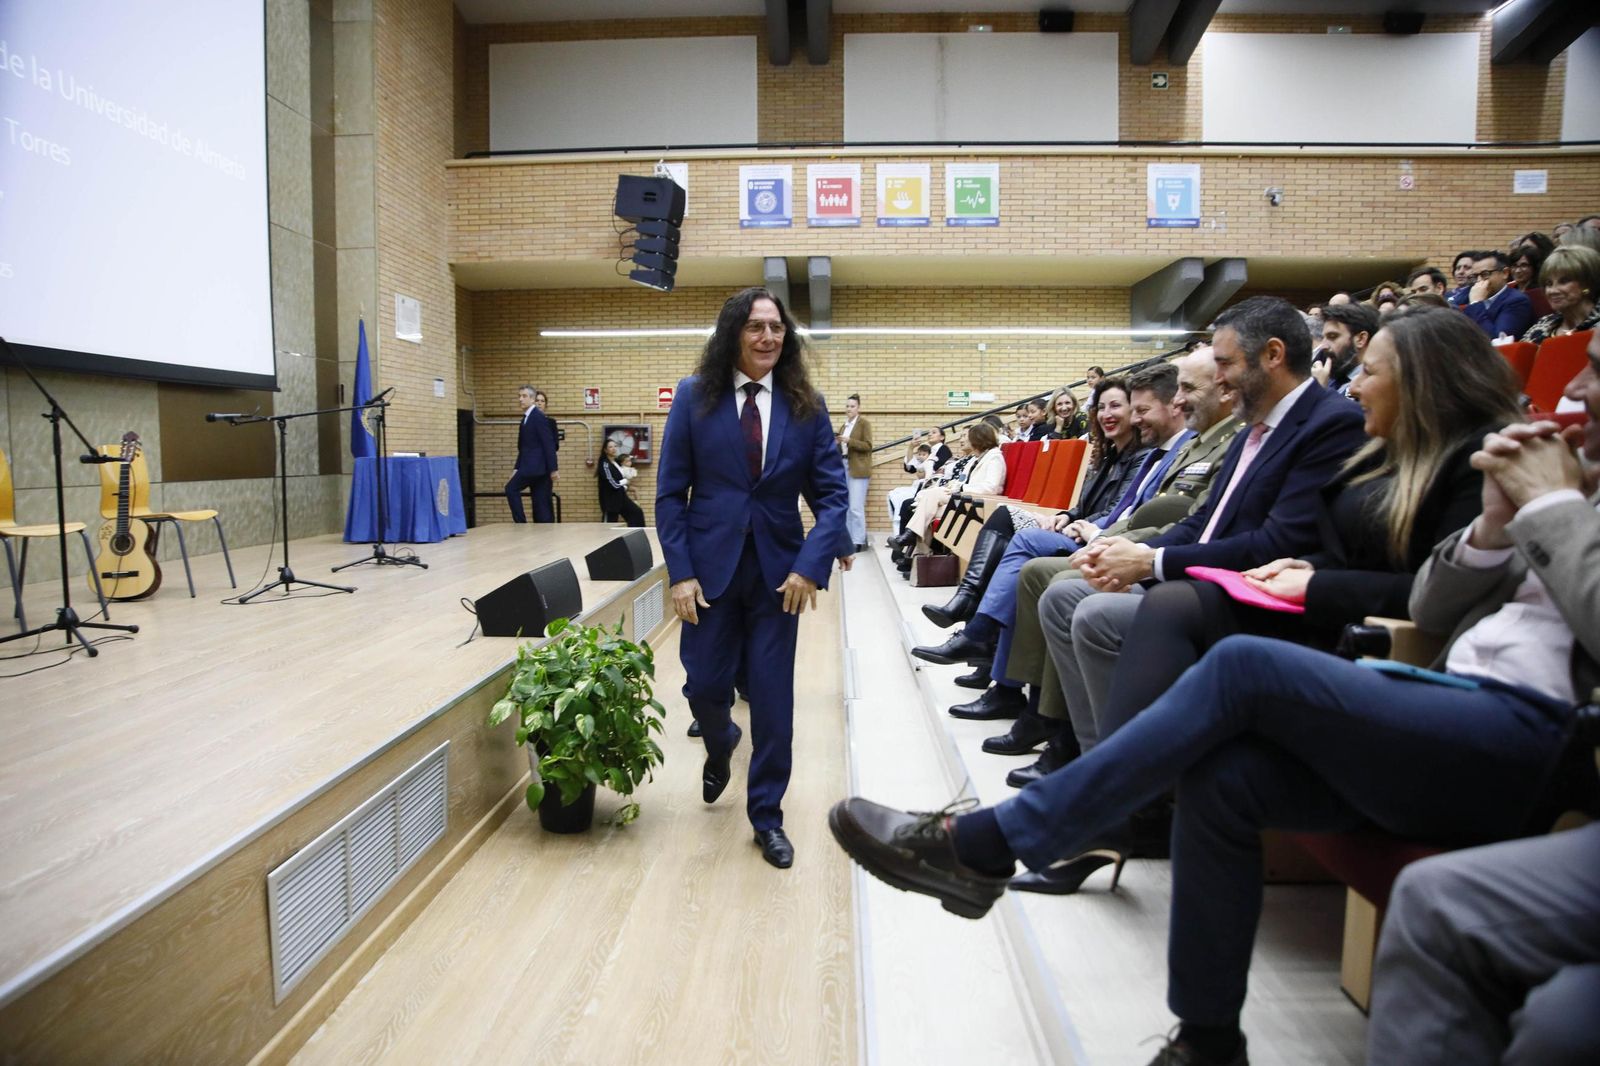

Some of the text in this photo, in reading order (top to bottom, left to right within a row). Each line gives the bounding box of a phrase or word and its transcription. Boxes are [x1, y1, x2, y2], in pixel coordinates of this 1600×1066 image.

[0, 40, 25, 79] de
[31, 54, 53, 91] la
[57, 68, 168, 145] Universidad
[171, 128, 193, 157] de
[3, 117, 71, 166] Torres
